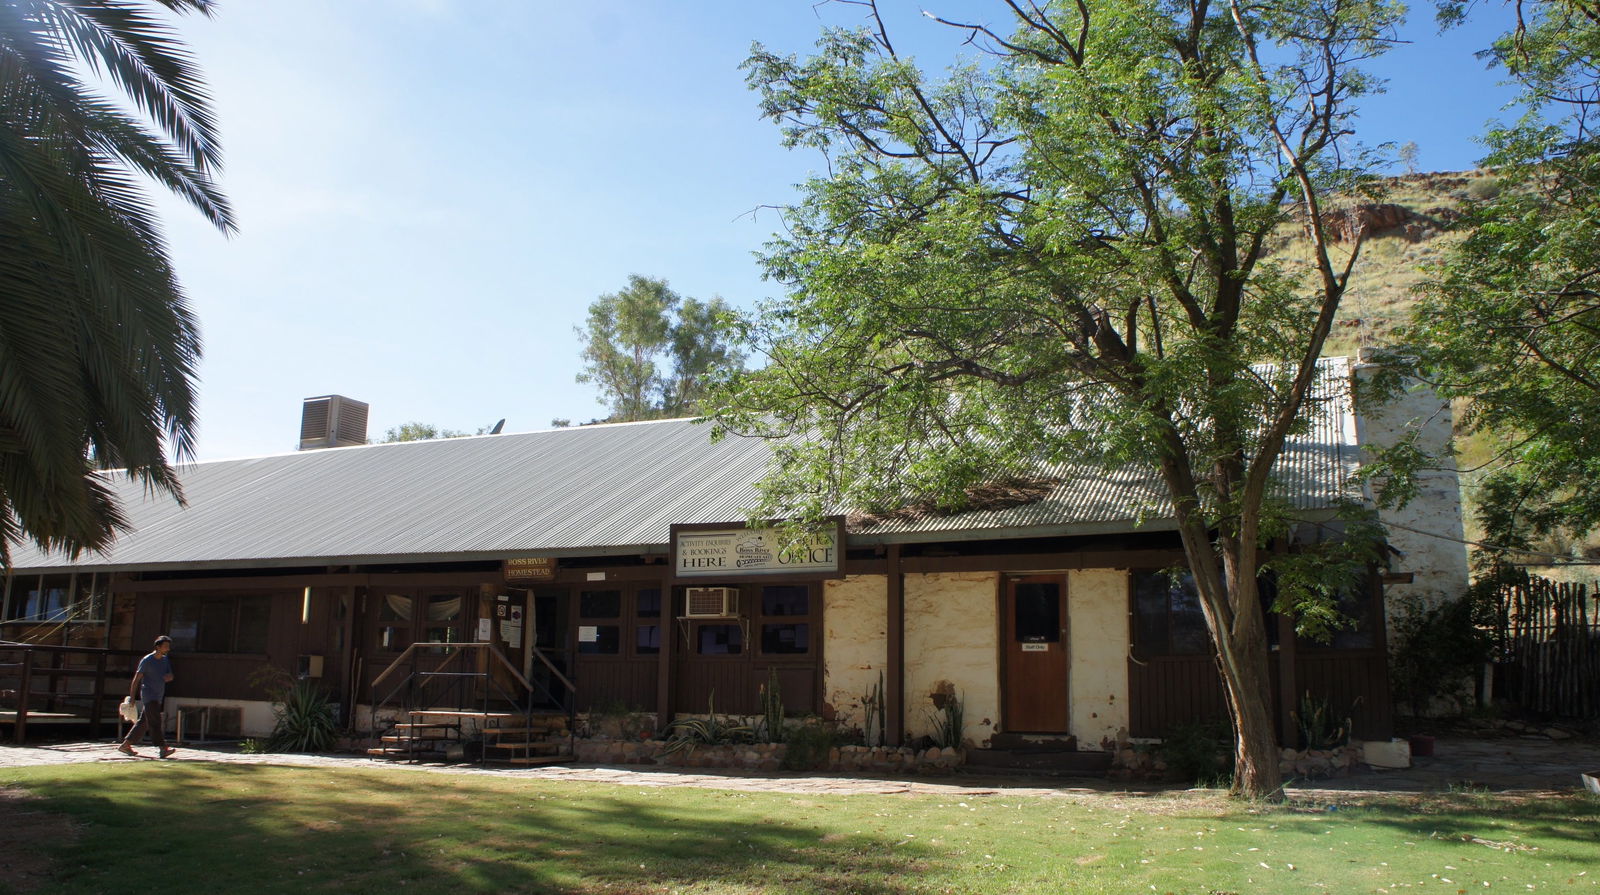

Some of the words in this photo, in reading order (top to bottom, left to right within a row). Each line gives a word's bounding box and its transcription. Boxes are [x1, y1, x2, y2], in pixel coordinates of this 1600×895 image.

[680, 540, 704, 548] ACTIVITY
[690, 547, 727, 556] BOOKINGS
[508, 558, 527, 566] ROSS
[527, 557, 548, 565] RIVER
[683, 557, 727, 568] HERE
[508, 568, 550, 577] HOMESTEAD
